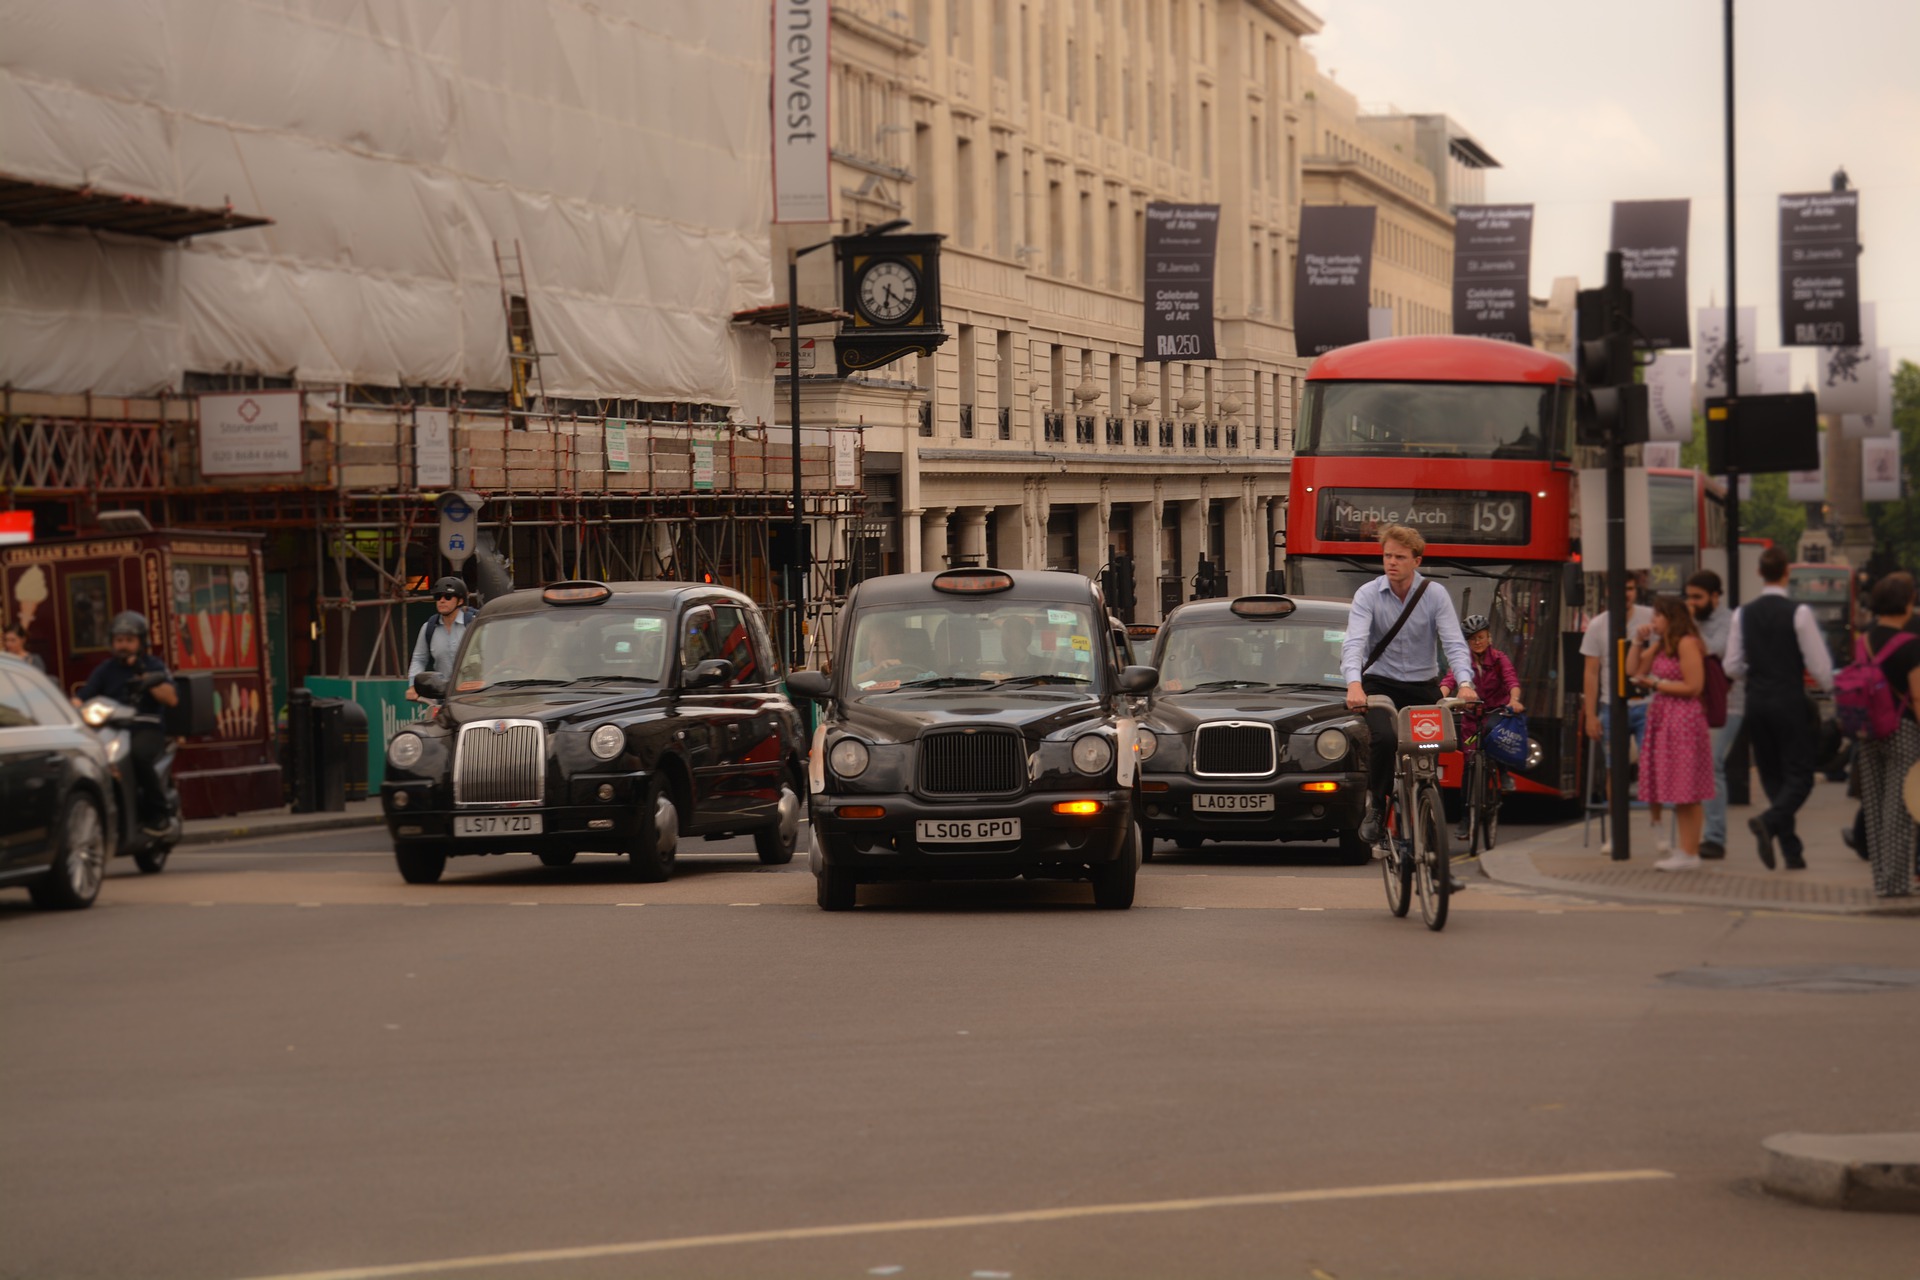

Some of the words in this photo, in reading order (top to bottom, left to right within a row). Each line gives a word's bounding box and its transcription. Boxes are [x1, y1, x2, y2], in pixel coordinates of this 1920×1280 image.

[787, 0, 817, 145] newest
[1148, 208, 1172, 221] Royal
[1175, 208, 1217, 221] Academy
[1458, 209, 1485, 221] Royal
[1487, 208, 1531, 220] Academy
[1166, 220, 1175, 230] of
[1178, 220, 1197, 230] Arts
[1477, 220, 1487, 229] of
[1489, 219, 1510, 229] Arts
[1306, 254, 1325, 265] Flag
[1328, 254, 1361, 265] artwork
[1307, 265, 1318, 276] by
[1320, 265, 1358, 275] Cornelia
[1309, 275, 1339, 285] Parker
[1157, 290, 1199, 300] Celebrate
[1156, 301, 1173, 311] 250
[1174, 301, 1200, 310] Years
[1165, 311, 1175, 321] of
[1176, 311, 1190, 320] Art
[1157, 334, 1200, 355] RA250
[219, 422, 279, 435] Stonewest
[1335, 505, 1399, 524] Marble
[1404, 507, 1447, 524] Arch
[1473, 501, 1516, 532] 159
[11, 546, 62, 562] ITALIAN
[66, 544, 86, 558] ICE
[89, 540, 135, 557] CREAM
[1651, 563, 1678, 585] 94
[1198, 795, 1236, 809] LA03
[1239, 795, 1268, 809] OSF
[464, 817, 497, 833] LS17
[501, 816, 531, 831] YZD
[924, 823, 972, 838] LS06
[977, 821, 1012, 837] GPO
